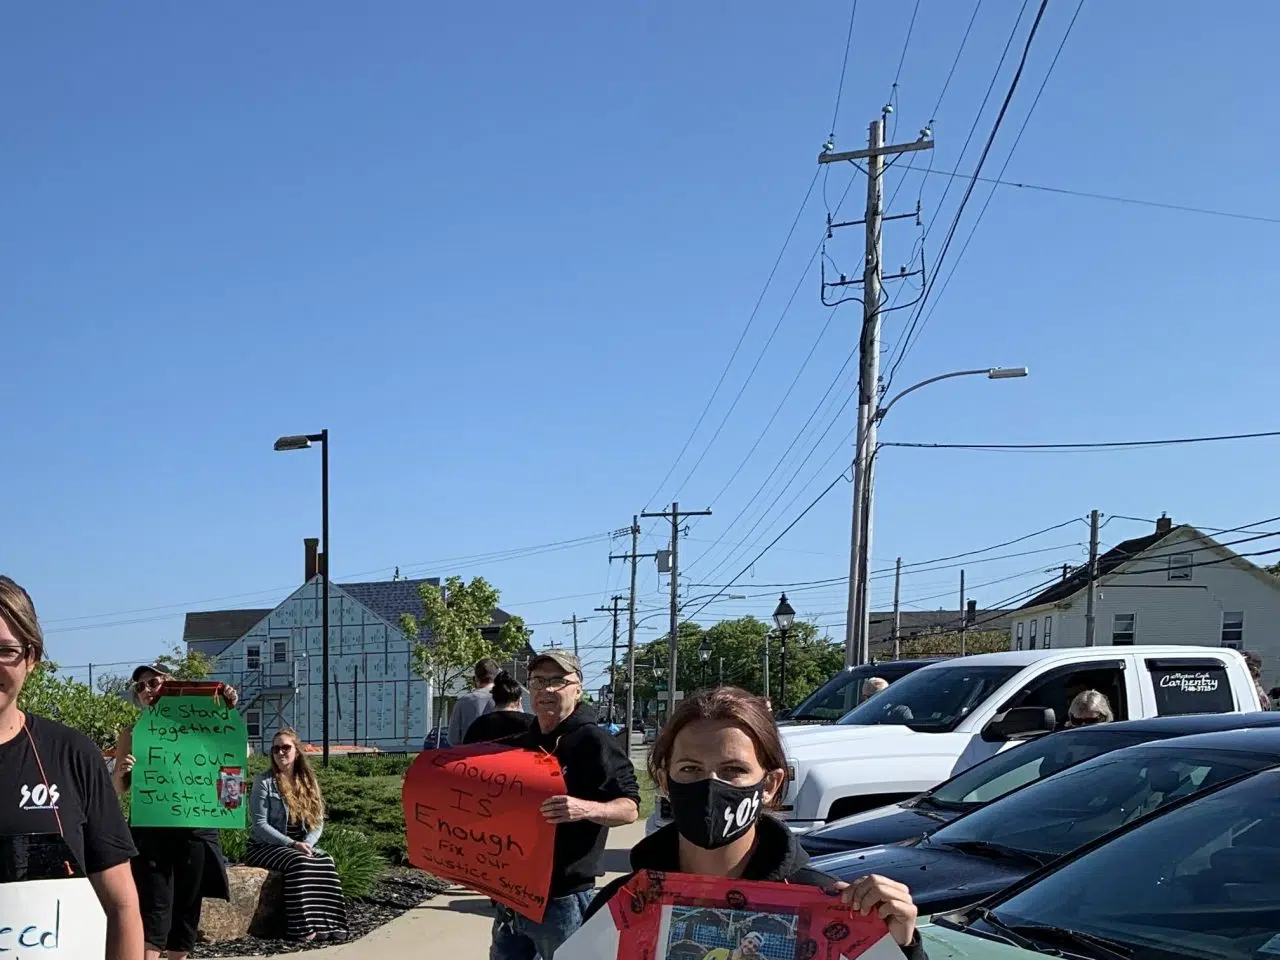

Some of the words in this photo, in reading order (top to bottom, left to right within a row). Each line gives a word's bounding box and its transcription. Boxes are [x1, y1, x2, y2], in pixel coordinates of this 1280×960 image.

[1160, 675, 1218, 691] Carpentry
[148, 704, 171, 718] We
[178, 703, 230, 720] Stand
[147, 720, 236, 742] together
[148, 746, 182, 765] Fix
[194, 751, 235, 767] our
[143, 769, 213, 786] Failded
[431, 752, 524, 798] Enough
[19, 783, 60, 808] SOS
[722, 790, 760, 838] SOS
[415, 802, 525, 857] Enough
[438, 839, 465, 857] Fix
[422, 846, 492, 881] Justice
